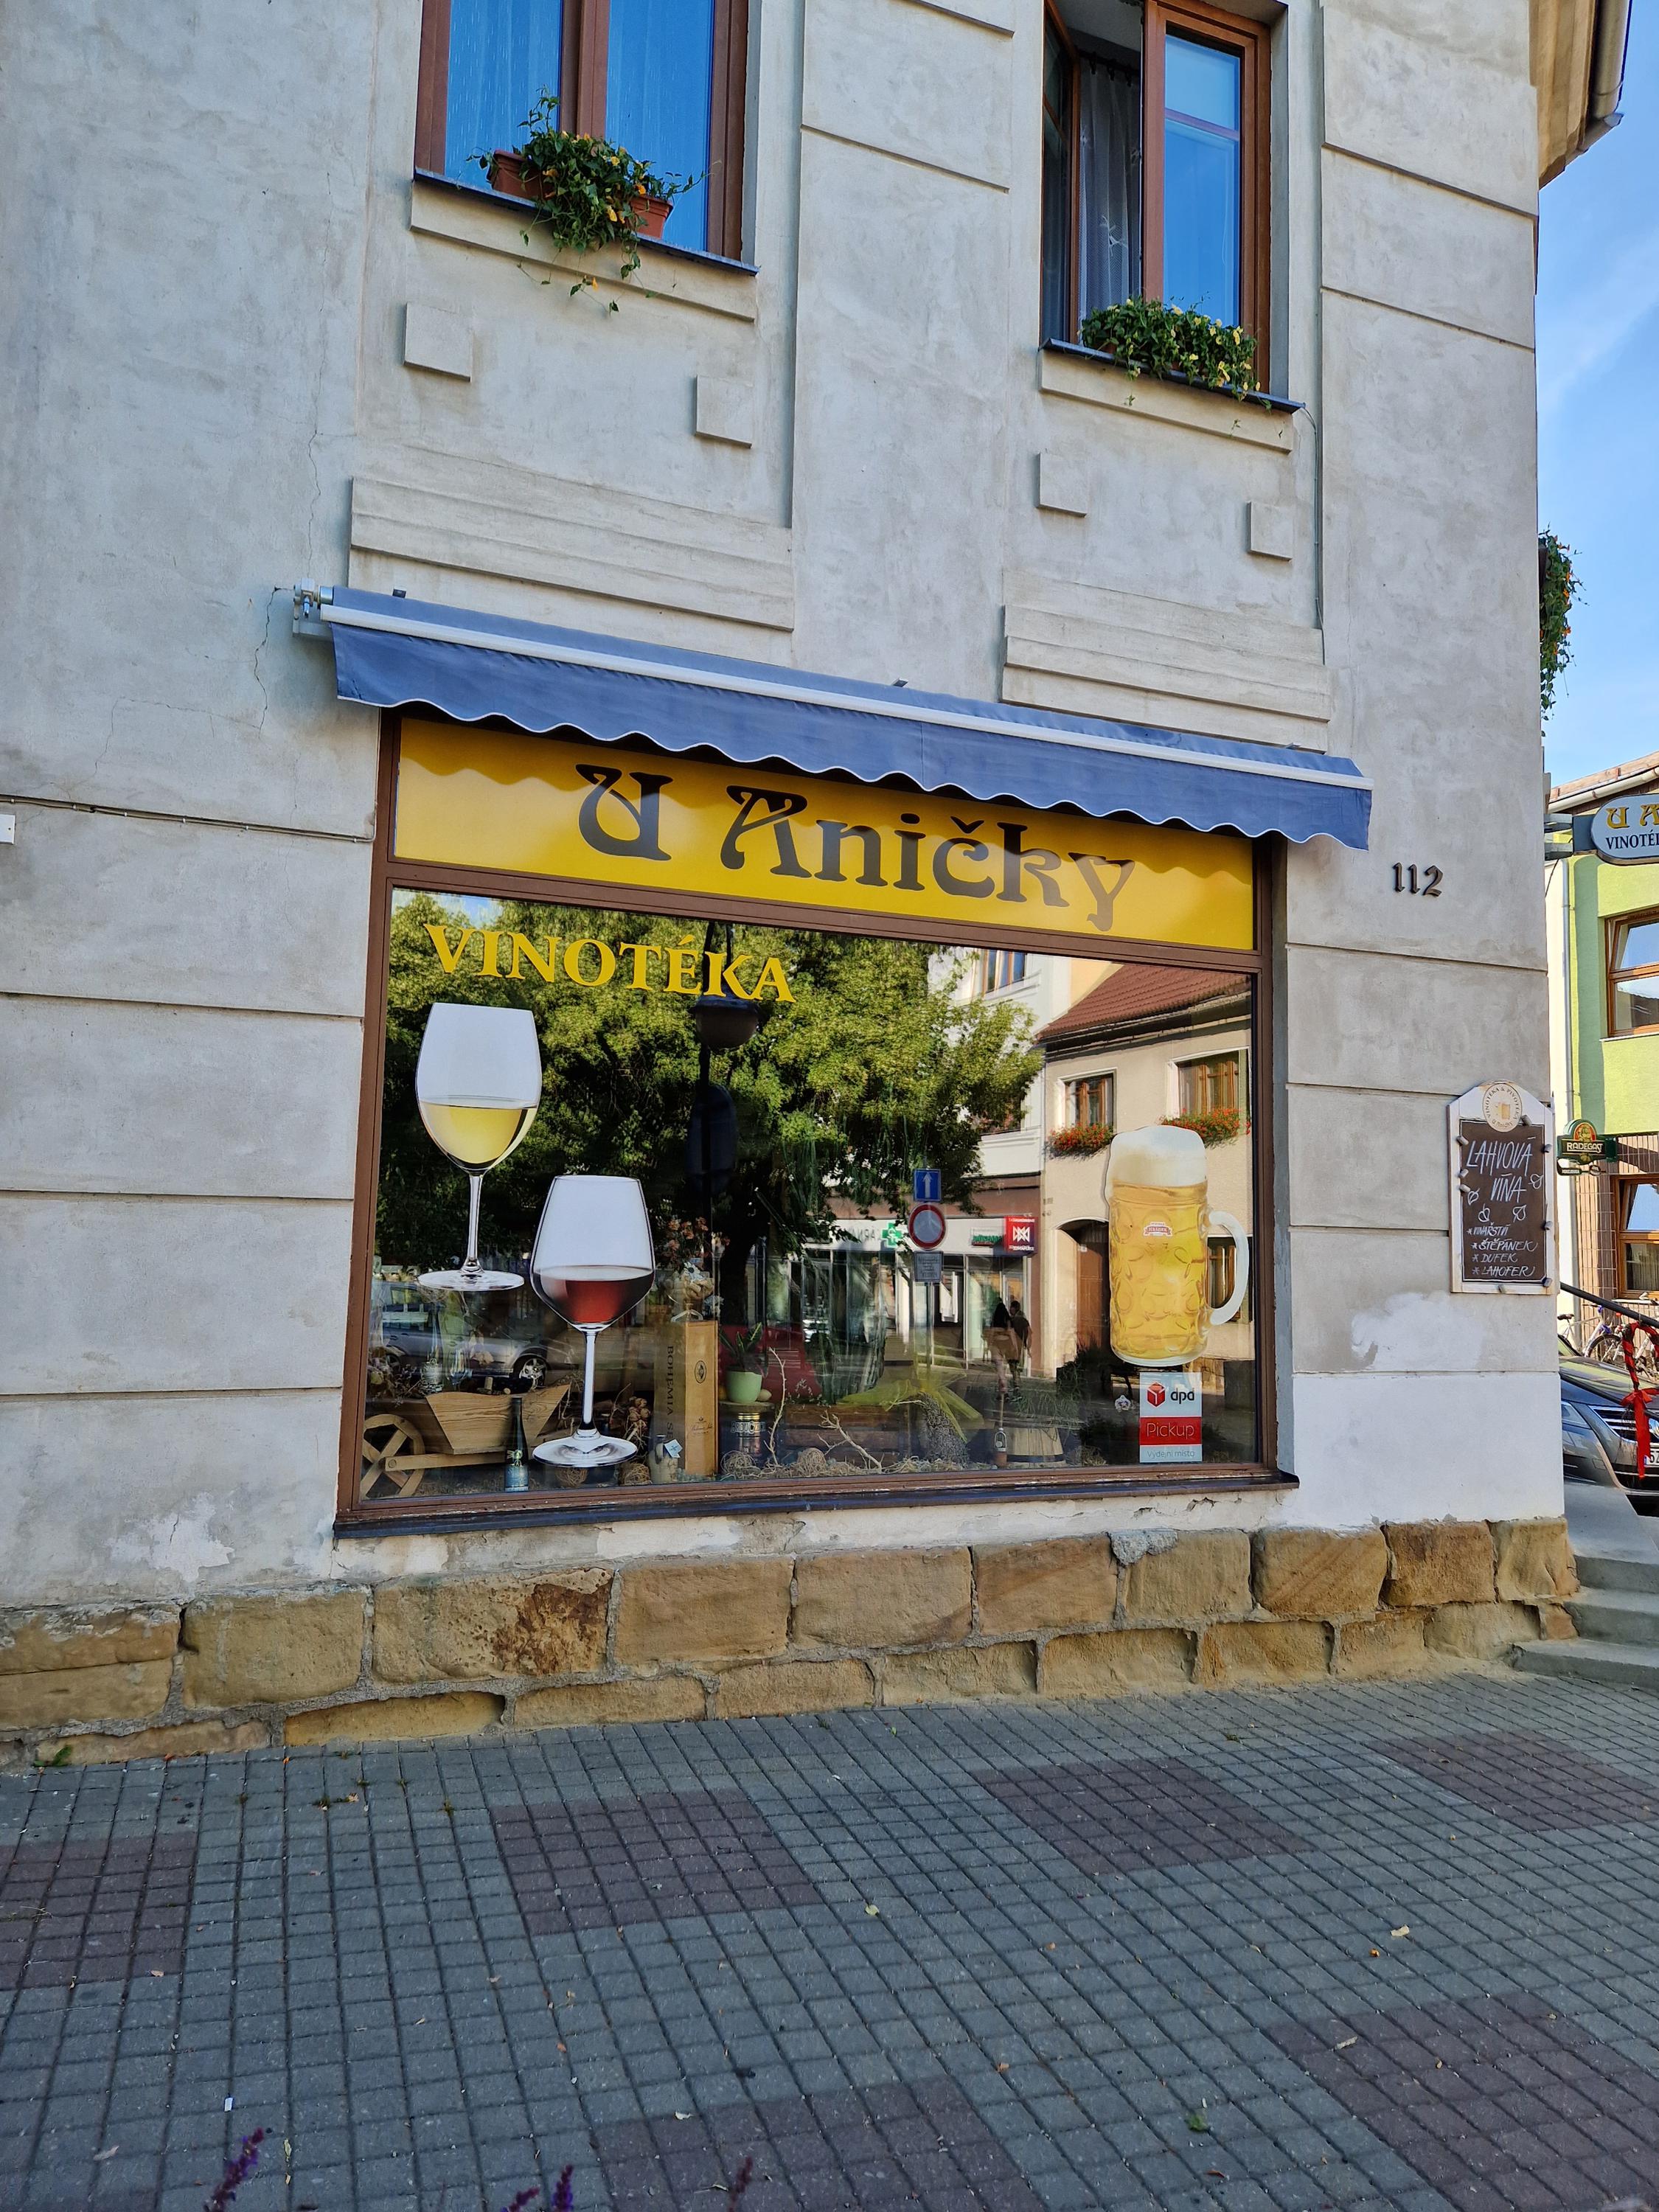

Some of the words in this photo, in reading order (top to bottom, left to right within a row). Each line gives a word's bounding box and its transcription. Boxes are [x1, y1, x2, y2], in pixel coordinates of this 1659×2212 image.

[1606, 807, 1630, 830] U
[575, 764, 672, 861] U
[720, 785, 1135, 932] Aničky
[1392, 862, 1444, 897] 112
[423, 923, 796, 1003] VINOTÉKA
[1467, 1135, 1537, 1178] LAHVOVÁ
[1566, 1141, 1604, 1153] RADEGAST
[1481, 1253, 1518, 1263] DUFEK
[1170, 1387, 1194, 1405] dpd
[1147, 1422, 1194, 1439] Pickup
[1175, 1449, 1195, 1457] místo
